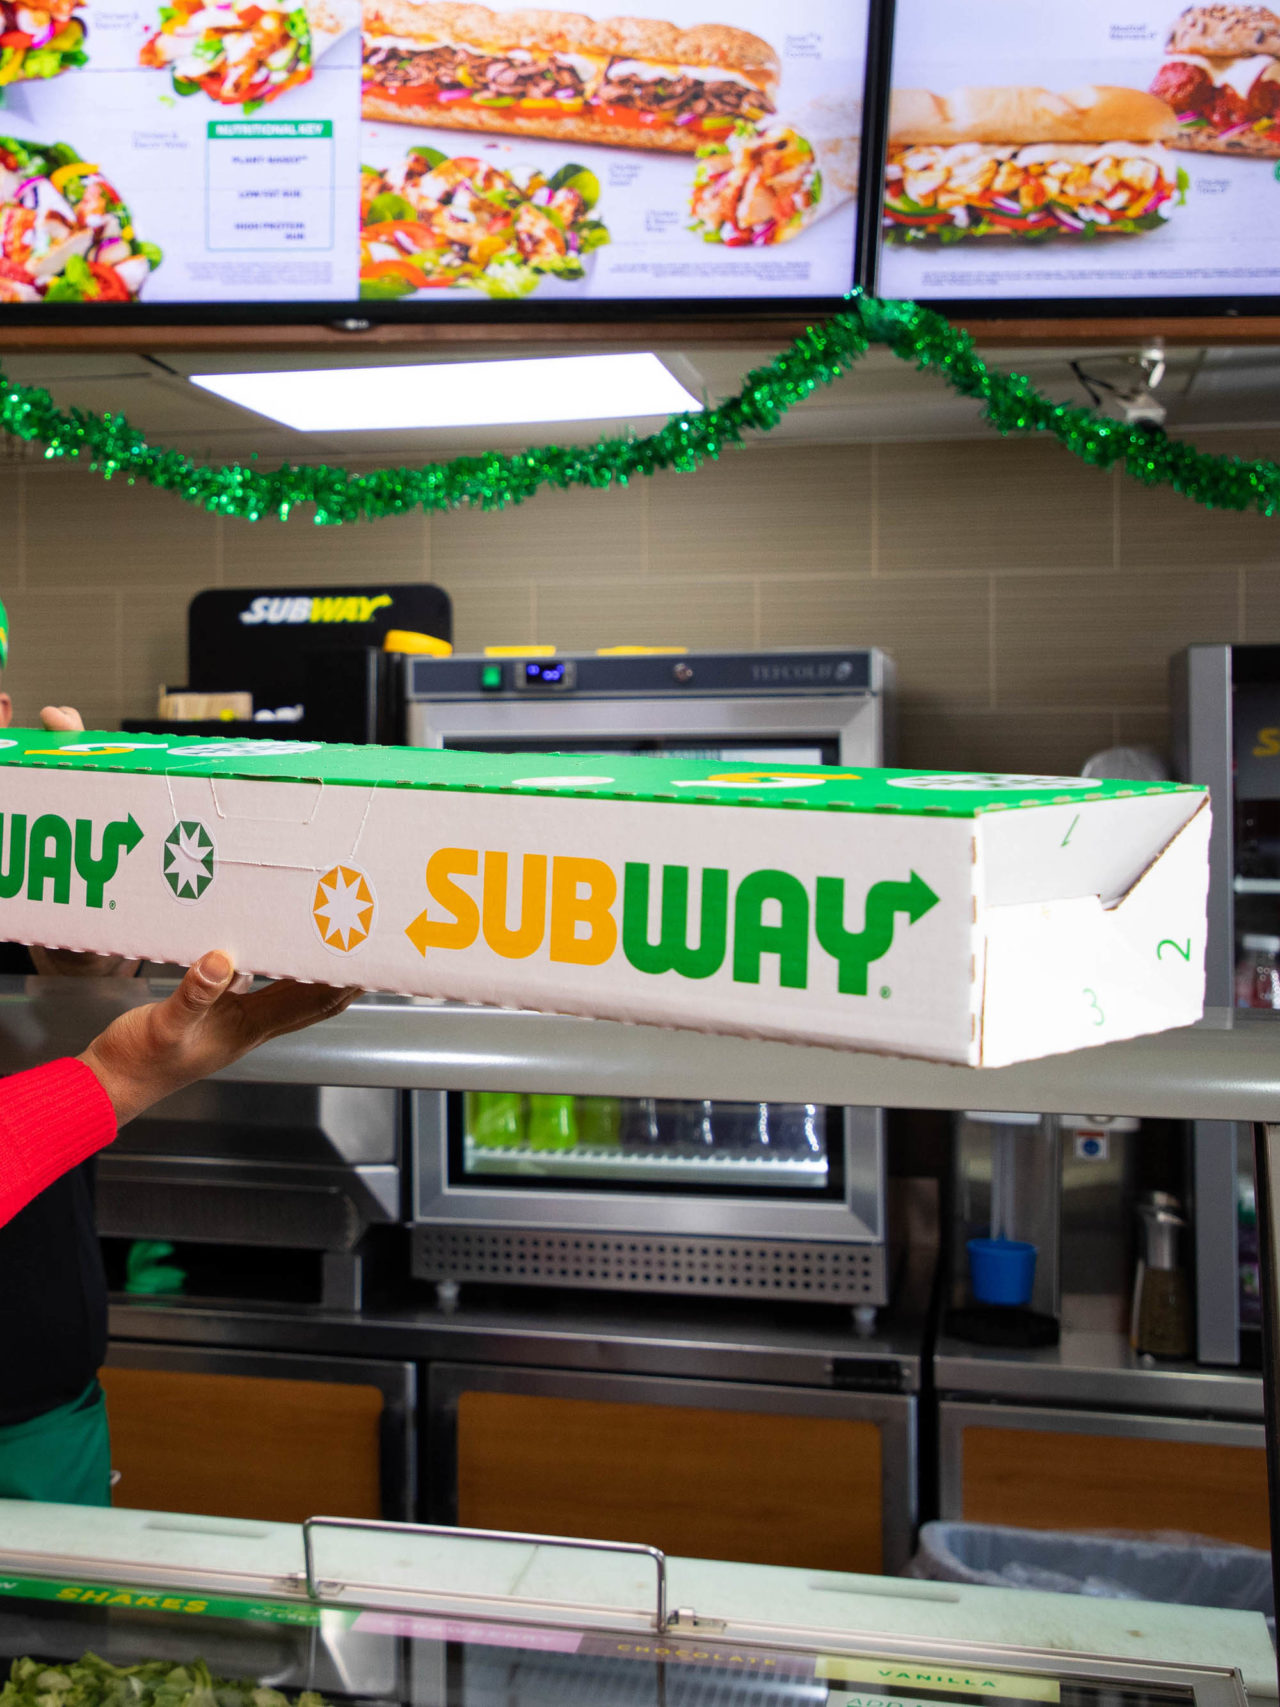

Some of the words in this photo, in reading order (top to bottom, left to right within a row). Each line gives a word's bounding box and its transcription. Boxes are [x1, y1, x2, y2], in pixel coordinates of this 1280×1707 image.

[239, 594, 393, 625] SUBWAY
[404, 847, 941, 996] SUBWAY
[1156, 937, 1191, 962] 2
[1082, 987, 1106, 1027] 3
[56, 1586, 209, 1613] SHAKES
[617, 1643, 777, 1667] CHOCOLATE
[877, 1669, 997, 1688] VANILLA
